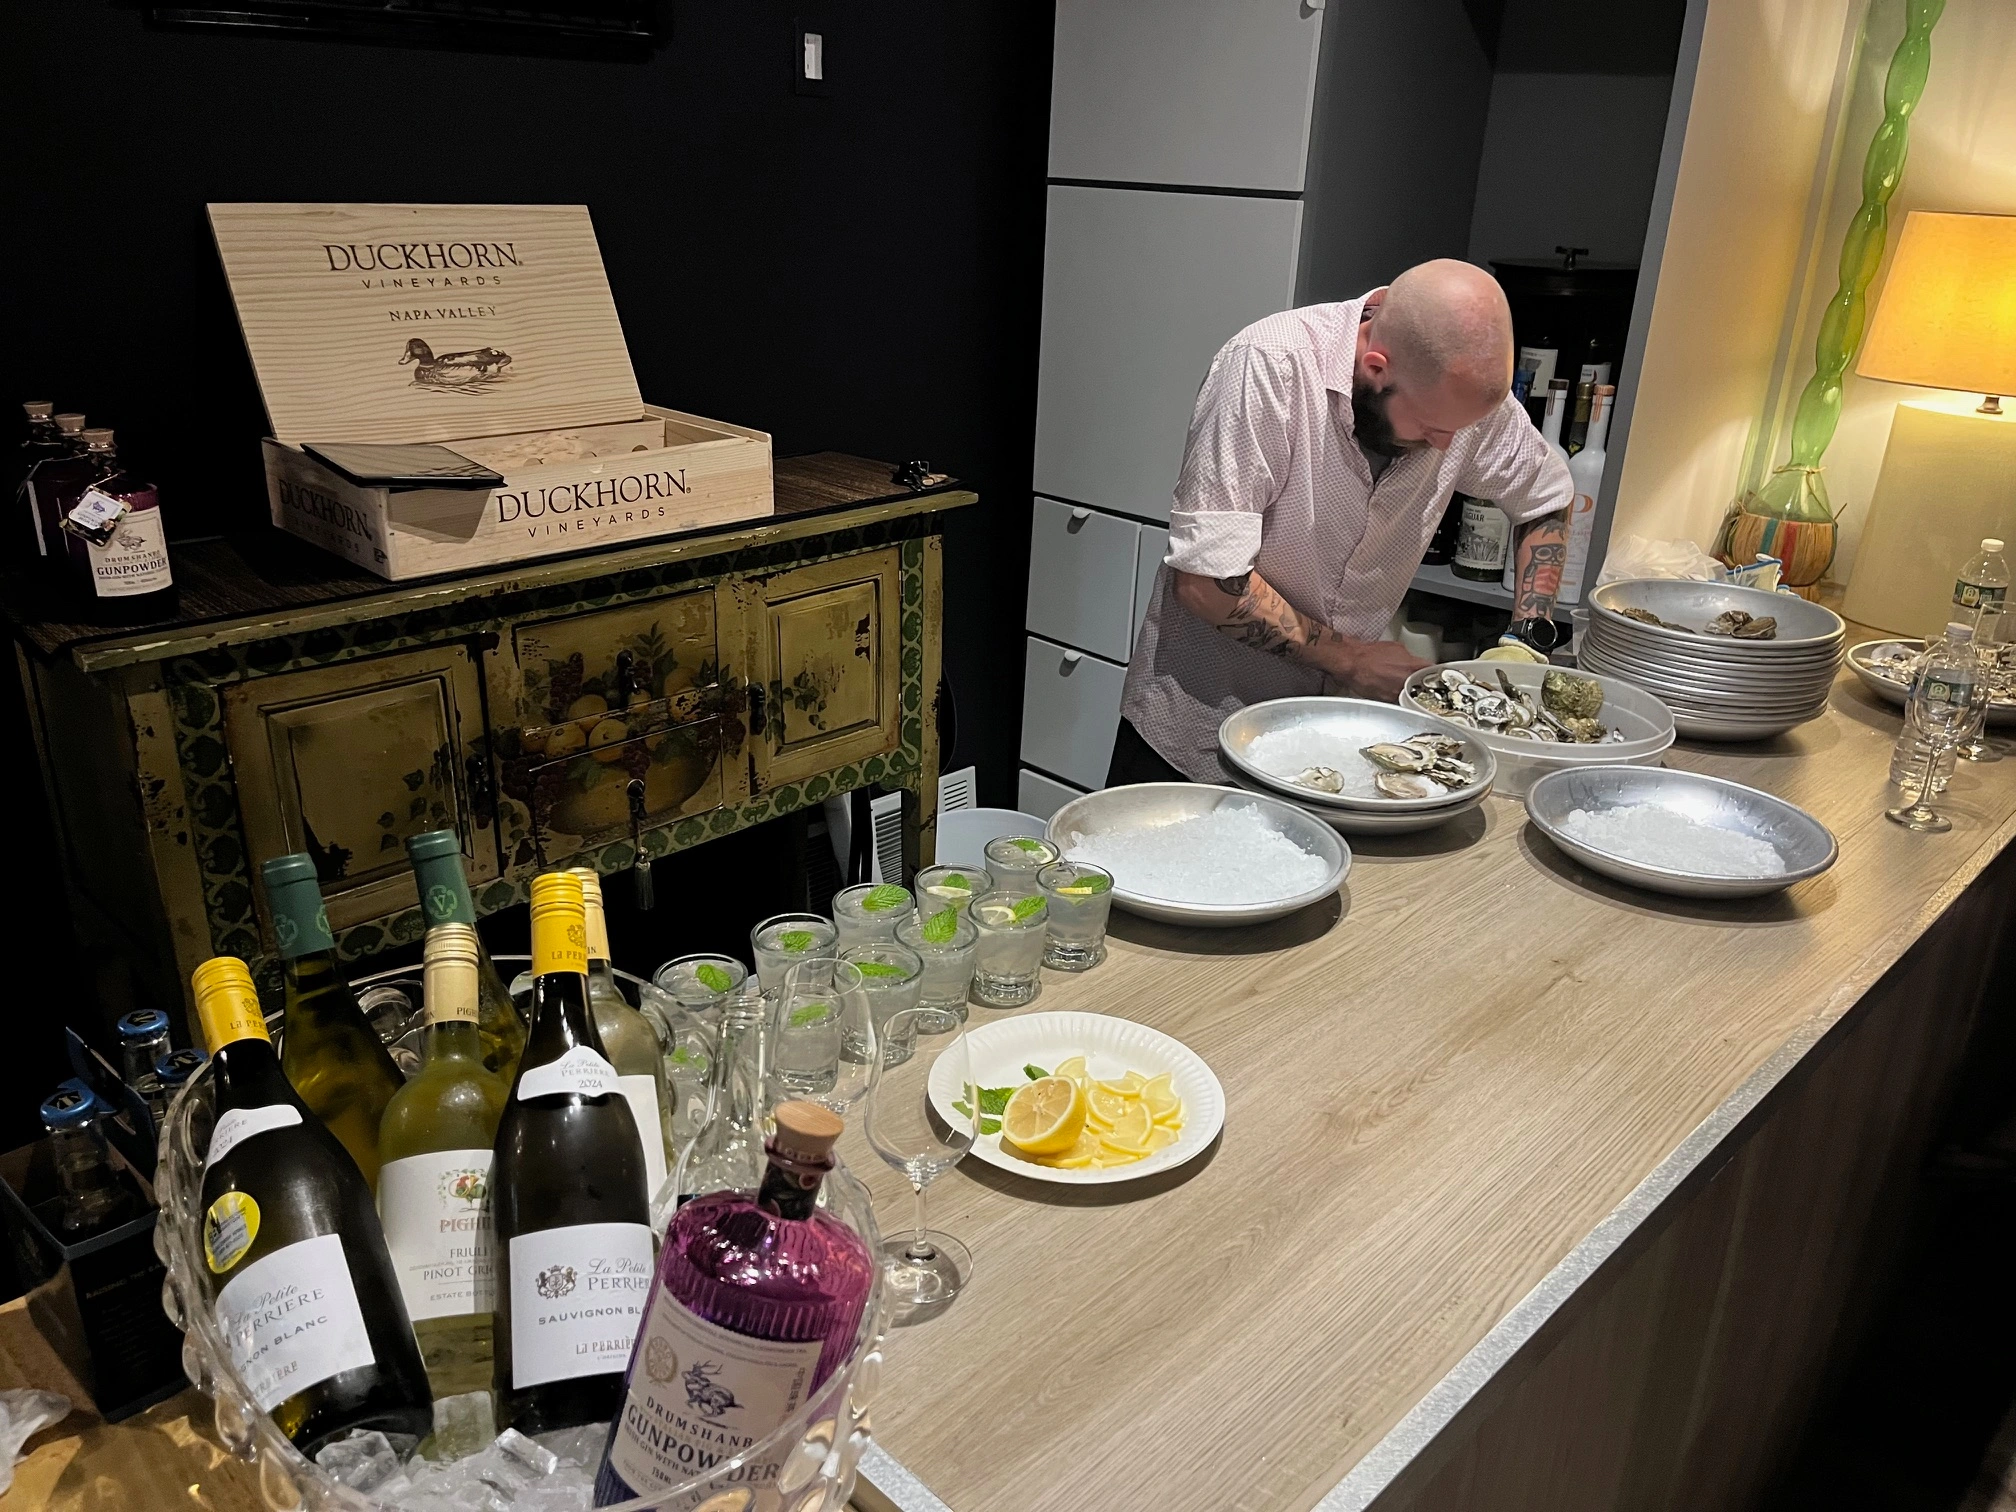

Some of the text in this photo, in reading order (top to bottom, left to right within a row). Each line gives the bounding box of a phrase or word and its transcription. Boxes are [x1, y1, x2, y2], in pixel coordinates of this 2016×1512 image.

[323, 242, 521, 272] DUCKHORN
[362, 275, 501, 289] VINEYARDS
[389, 305, 497, 322] NAPA VALLEY
[528, 507, 666, 538] VINEYARDS
[97, 557, 167, 576] GUNPOWDER
[578, 1079, 603, 1089] 2024
[423, 1266, 463, 1281] PINOT
[588, 1257, 648, 1275] La Petite
[254, 1283, 300, 1314] Petite
[430, 1291, 463, 1302] ESTATE
[538, 1306, 623, 1326] SAUVIGNON
[273, 1315, 329, 1346] BLANC
[655, 1453, 680, 1472] WITH
